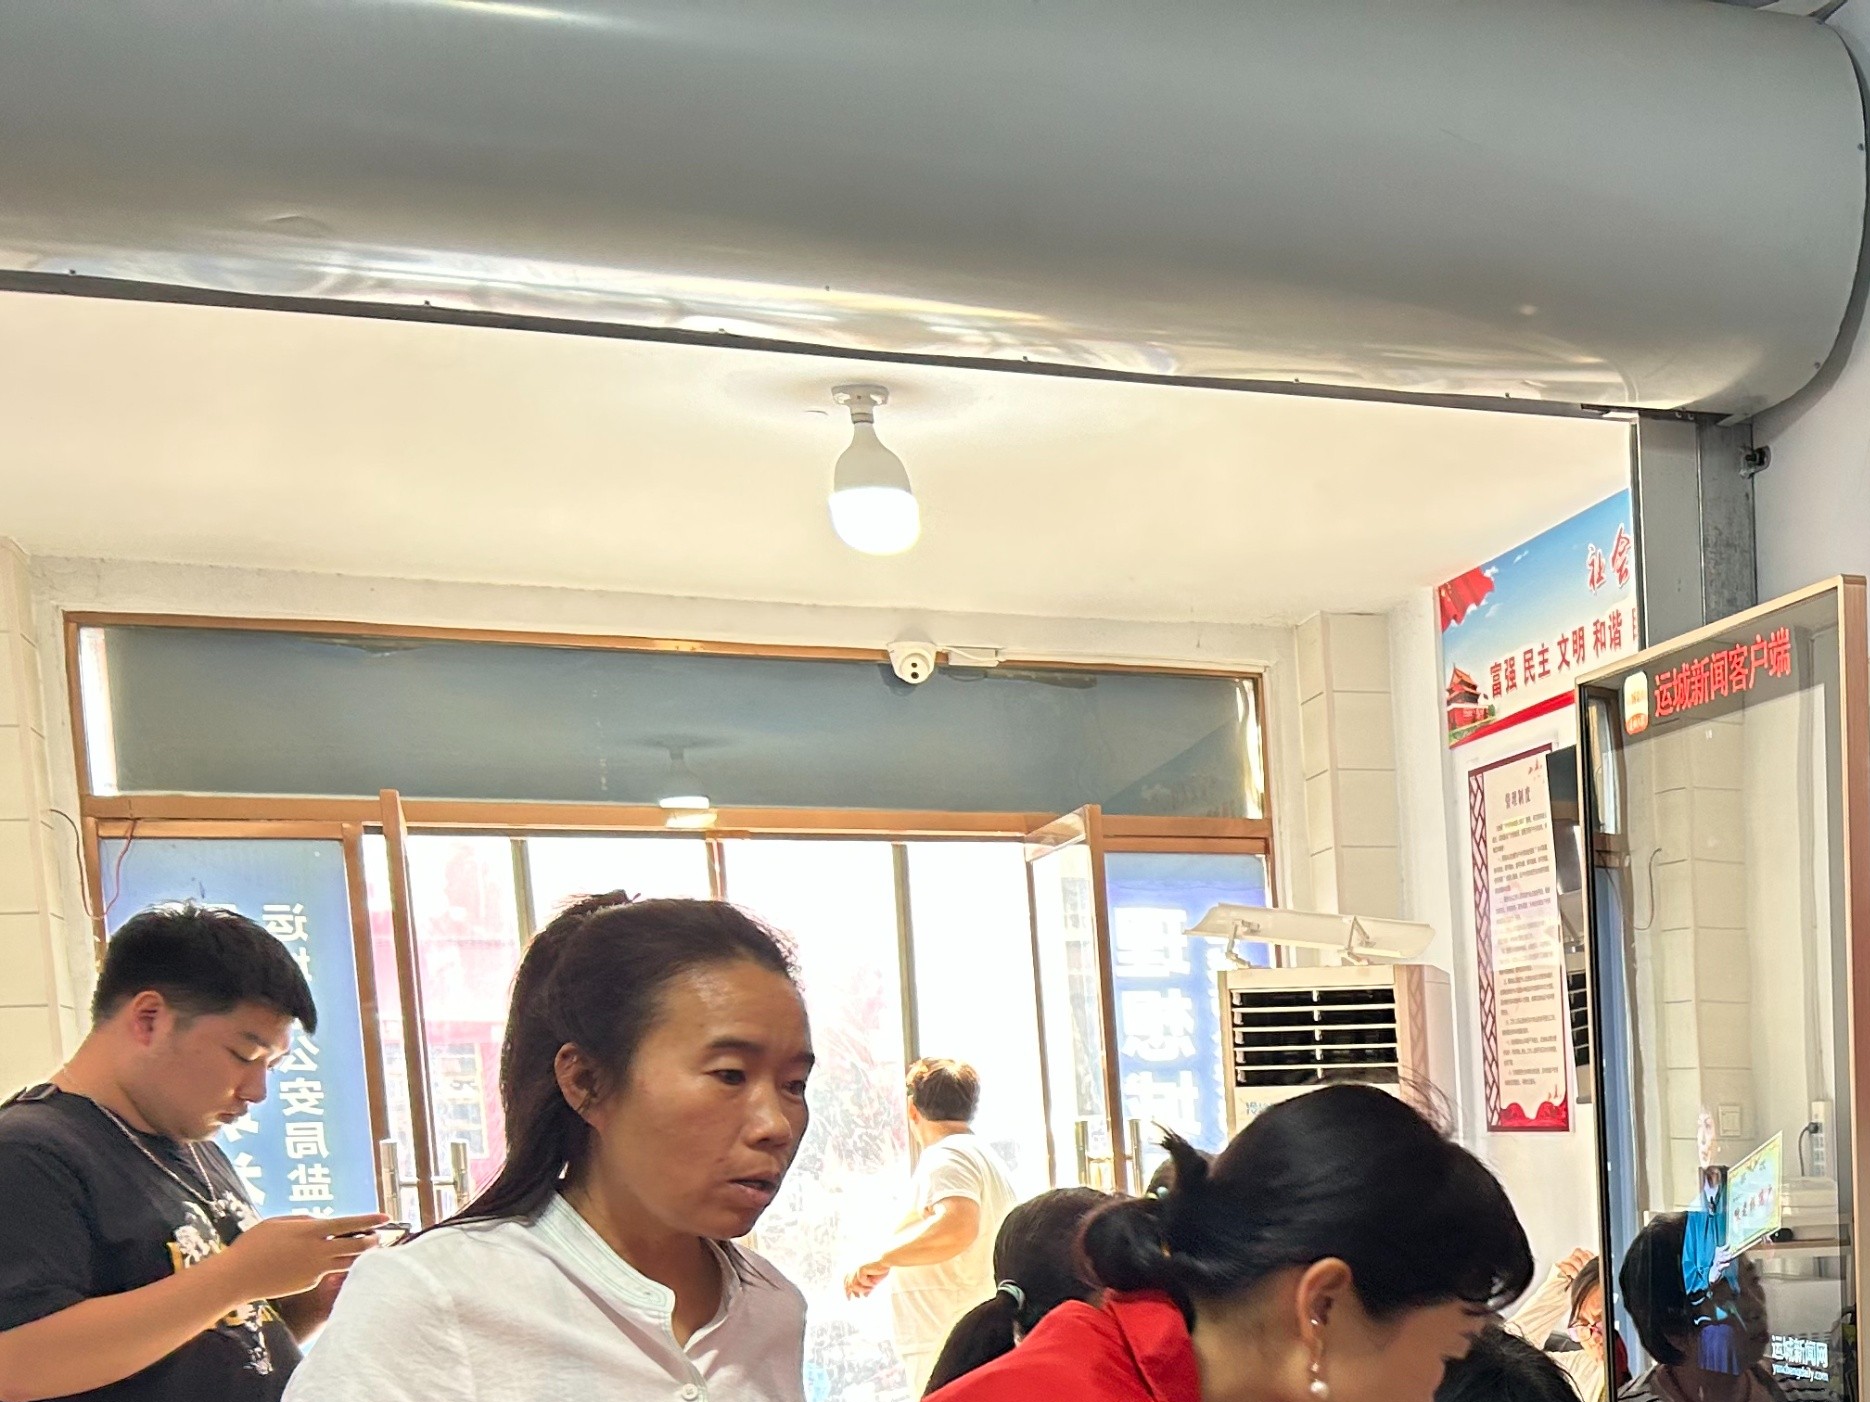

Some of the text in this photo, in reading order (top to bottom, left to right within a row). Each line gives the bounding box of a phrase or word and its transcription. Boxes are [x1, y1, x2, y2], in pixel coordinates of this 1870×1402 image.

[1490, 656, 1517, 699] 富强
[1524, 643, 1551, 685] 民主
[1557, 626, 1585, 670] 文明
[1593, 609, 1622, 658] 和谐
[1654, 627, 1791, 717] 运城新闻客户端
